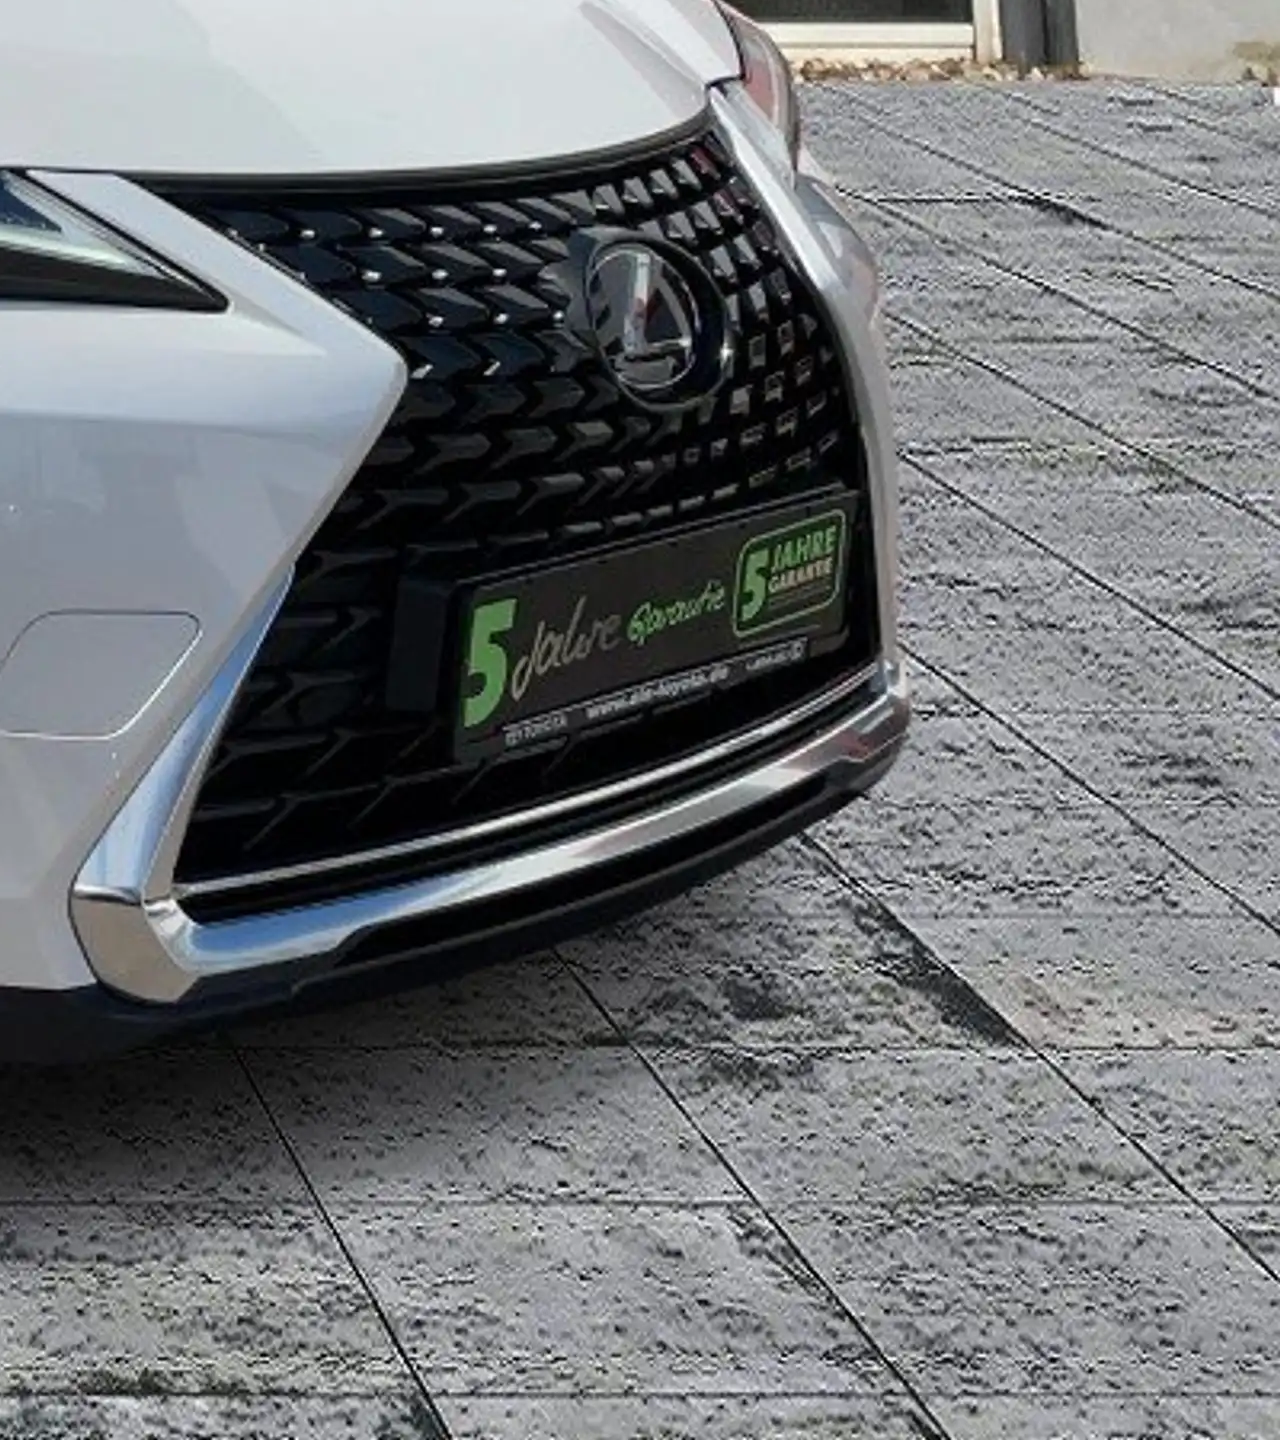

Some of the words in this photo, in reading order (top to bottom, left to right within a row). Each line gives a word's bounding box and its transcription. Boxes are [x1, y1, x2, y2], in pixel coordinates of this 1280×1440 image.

[741, 548, 770, 622] 5
[771, 524, 838, 574] JAHRE
[462, 598, 518, 728] 5
[511, 596, 623, 702] Jahre
